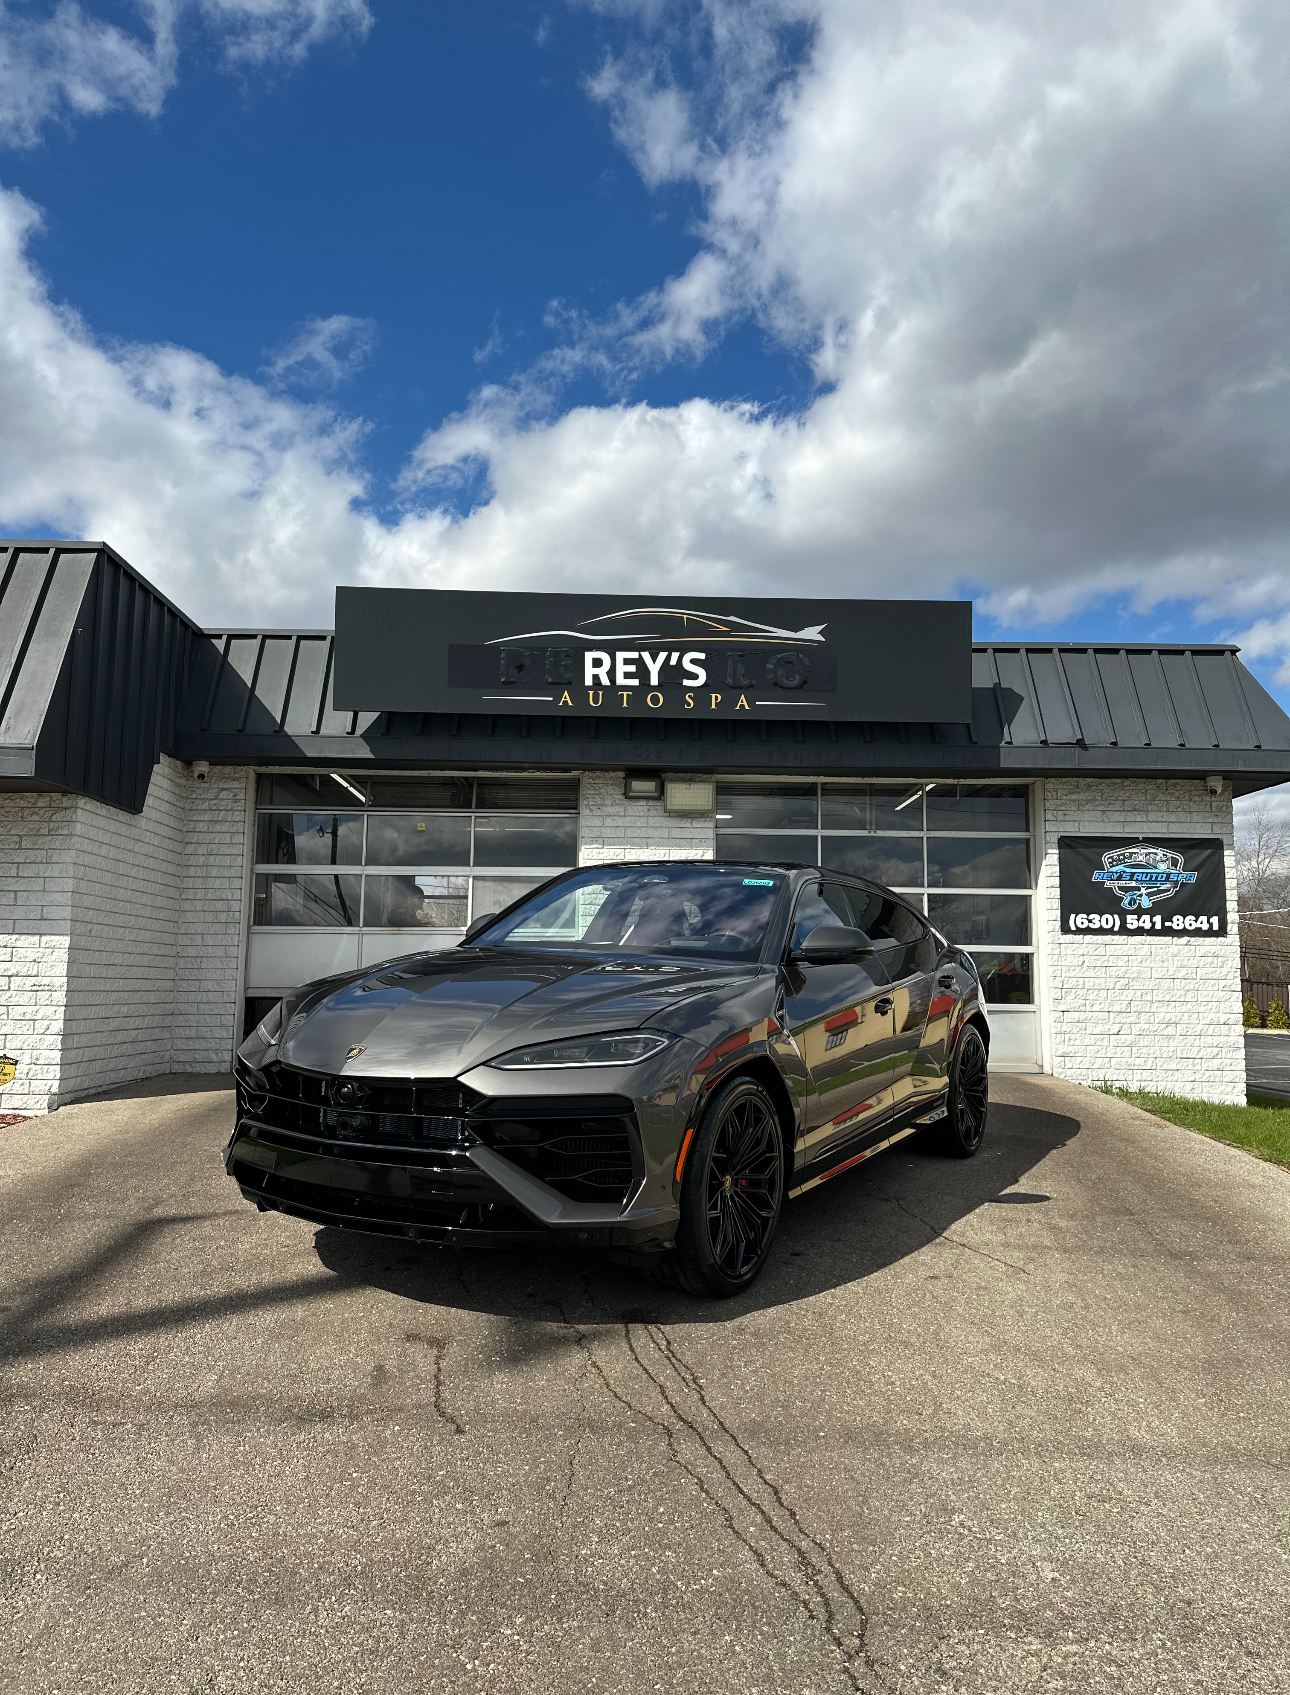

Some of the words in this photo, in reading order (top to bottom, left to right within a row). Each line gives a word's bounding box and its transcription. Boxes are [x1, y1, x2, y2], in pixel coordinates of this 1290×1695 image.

[584, 651, 707, 687] REY'S
[558, 690, 664, 708] AUTO
[684, 692, 751, 710] SPA
[1094, 872, 1131, 880] REY'S
[1133, 873, 1167, 881] AUTO
[1169, 873, 1195, 882] SPA
[1069, 913, 1121, 931] (630)
[1126, 914, 1219, 930] 541-8641
